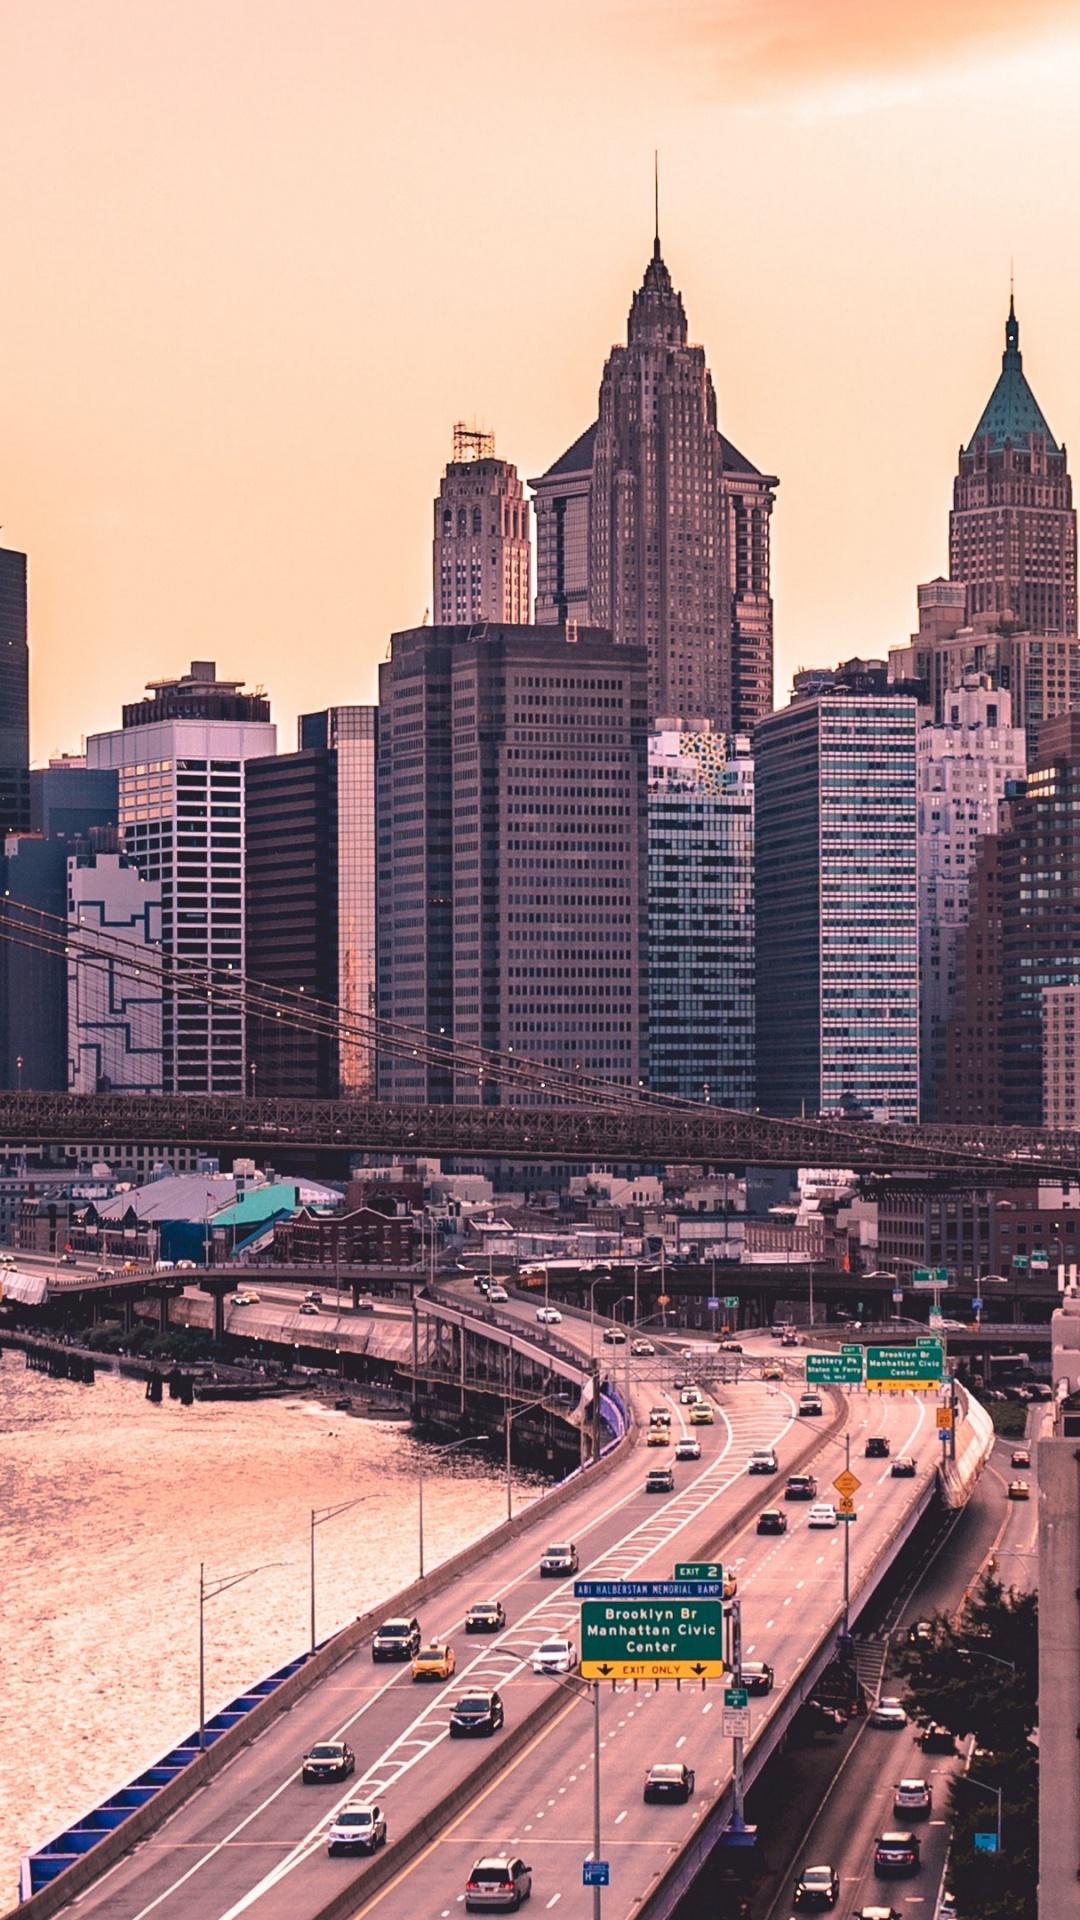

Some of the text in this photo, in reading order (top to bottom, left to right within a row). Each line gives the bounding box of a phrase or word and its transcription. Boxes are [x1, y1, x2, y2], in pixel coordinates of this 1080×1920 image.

[879, 1351, 917, 1359] Brooklyn
[811, 1357, 843, 1366] Battery
[679, 1566, 718, 1577] EXIT 2
[578, 1584, 592, 1594] ARI
[652, 1584, 692, 1594] MEMORIAL
[697, 1584, 719, 1594] RAMP
[605, 1607, 697, 1622] Brooklyn Br
[587, 1624, 716, 1636] Manhattan Civic
[626, 1641, 677, 1652] Center
[623, 1665, 681, 1674] EXIT ONLY
